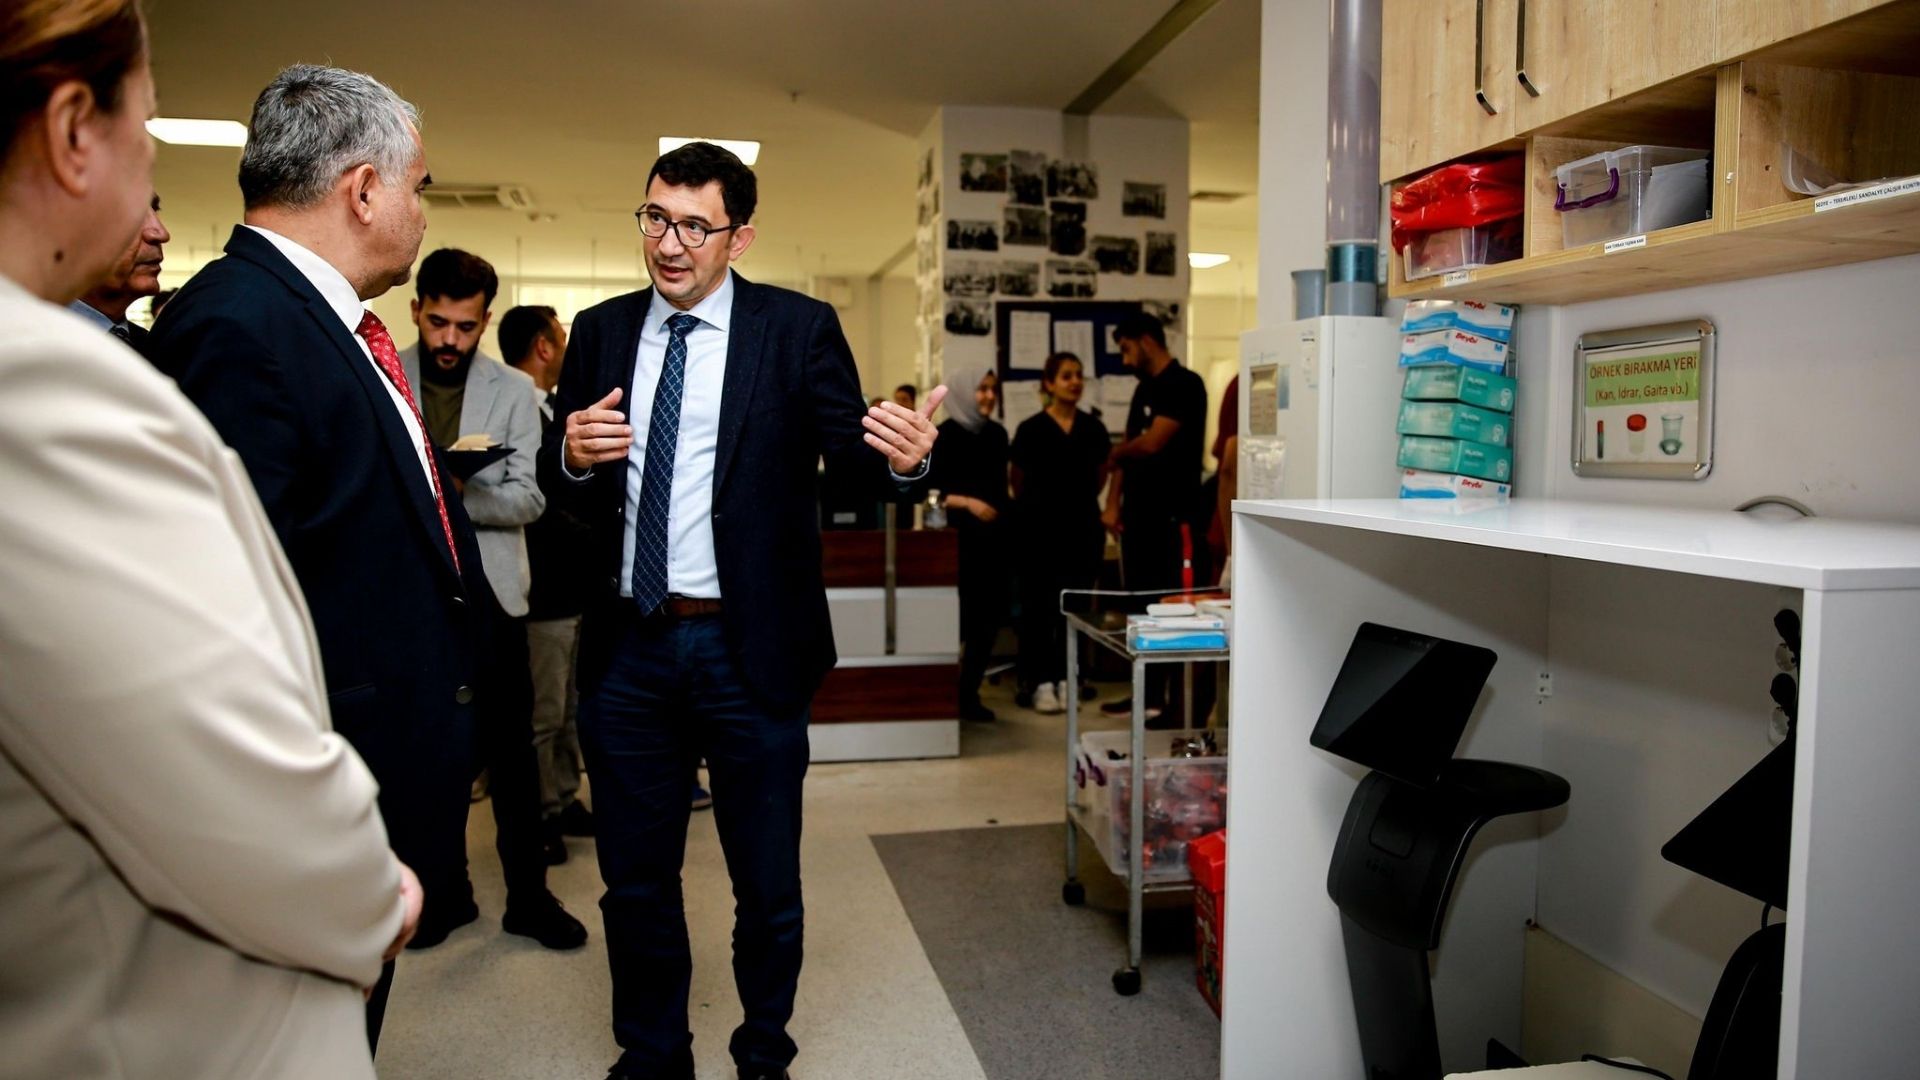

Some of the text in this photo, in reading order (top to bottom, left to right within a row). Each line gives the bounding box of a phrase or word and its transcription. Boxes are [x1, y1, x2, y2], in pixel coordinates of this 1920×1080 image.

[1624, 359, 1670, 376] BIRAKMA
[1643, 385, 1668, 397] Gaita
[1670, 381, 1689, 396] vb.)
